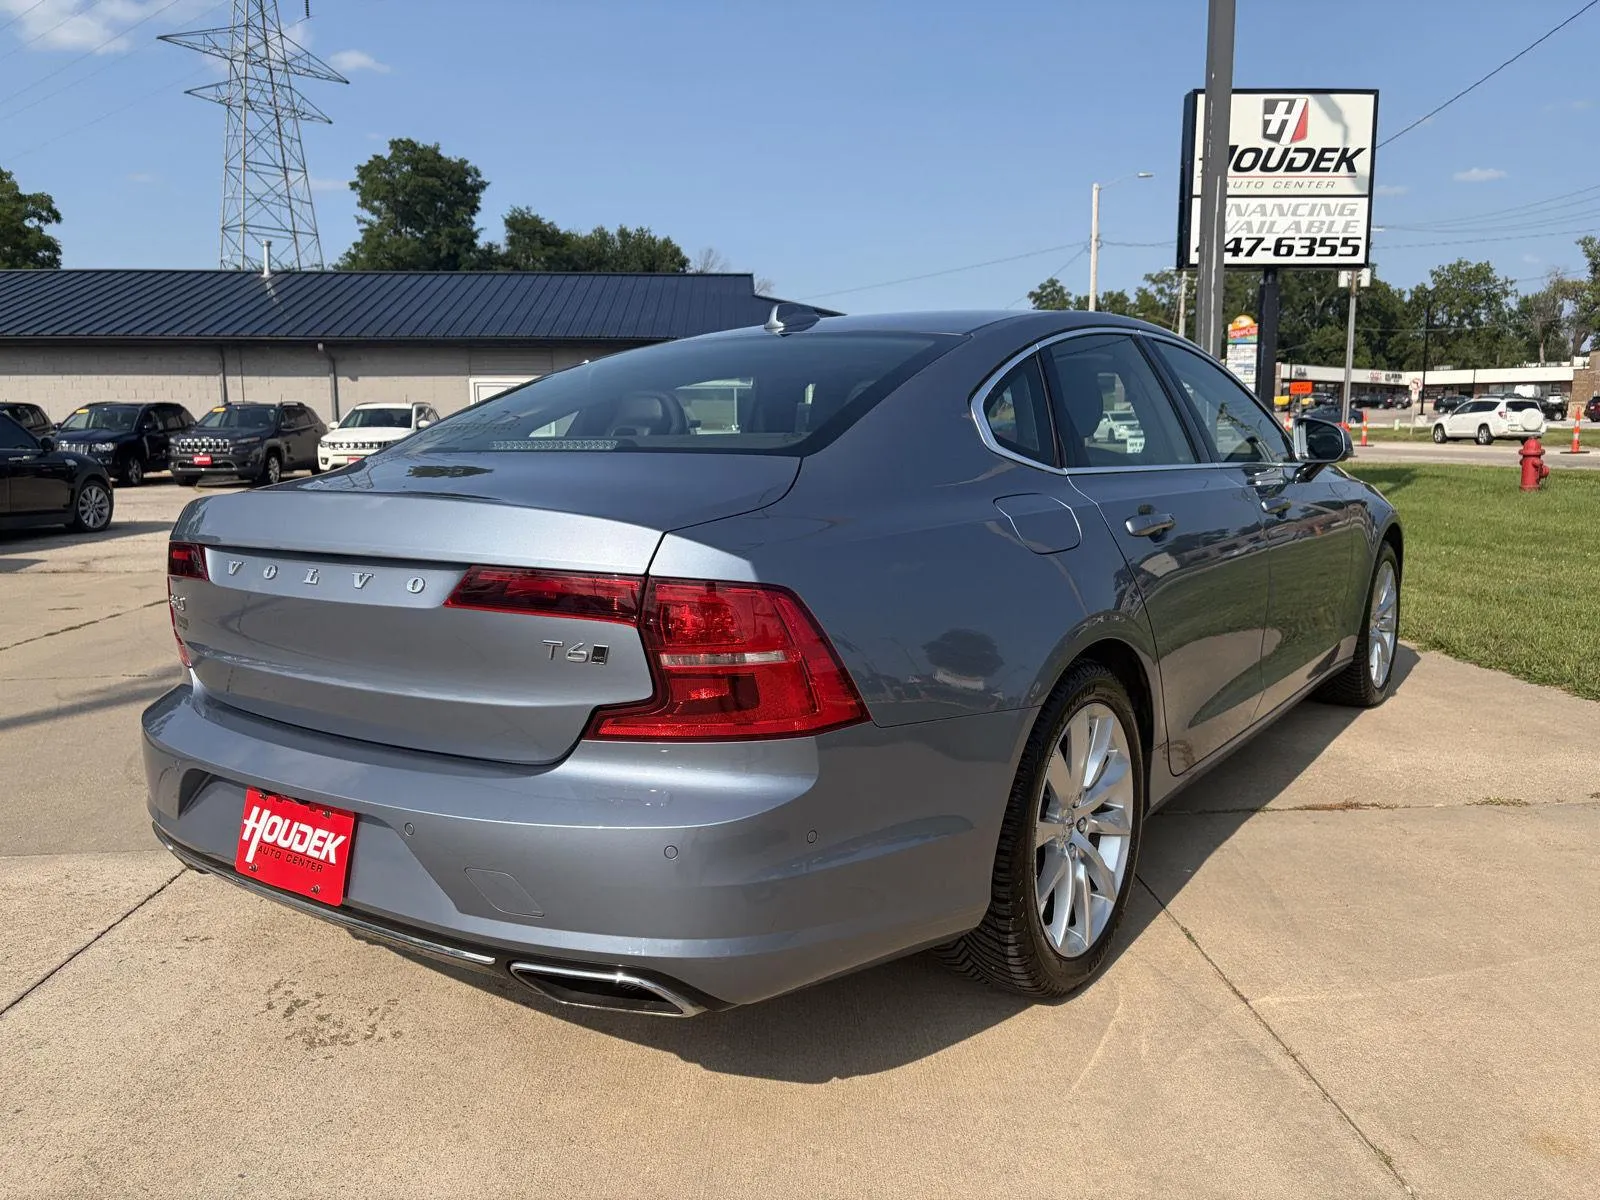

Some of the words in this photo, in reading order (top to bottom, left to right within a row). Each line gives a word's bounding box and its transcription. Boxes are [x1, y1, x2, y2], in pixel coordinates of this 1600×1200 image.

[1227, 180, 1264, 189] UTO
[1272, 180, 1336, 189] CENTER
[1226, 202, 1359, 217] NANCING
[1225, 219, 1361, 234] VAILABLE
[1195, 236, 1362, 257] 47-6355
[228, 559, 426, 595] VOLVO
[541, 639, 588, 663] T6
[242, 805, 347, 864] HOUDEK
[257, 845, 282, 860] AUTO
[285, 853, 324, 873] CENTER
